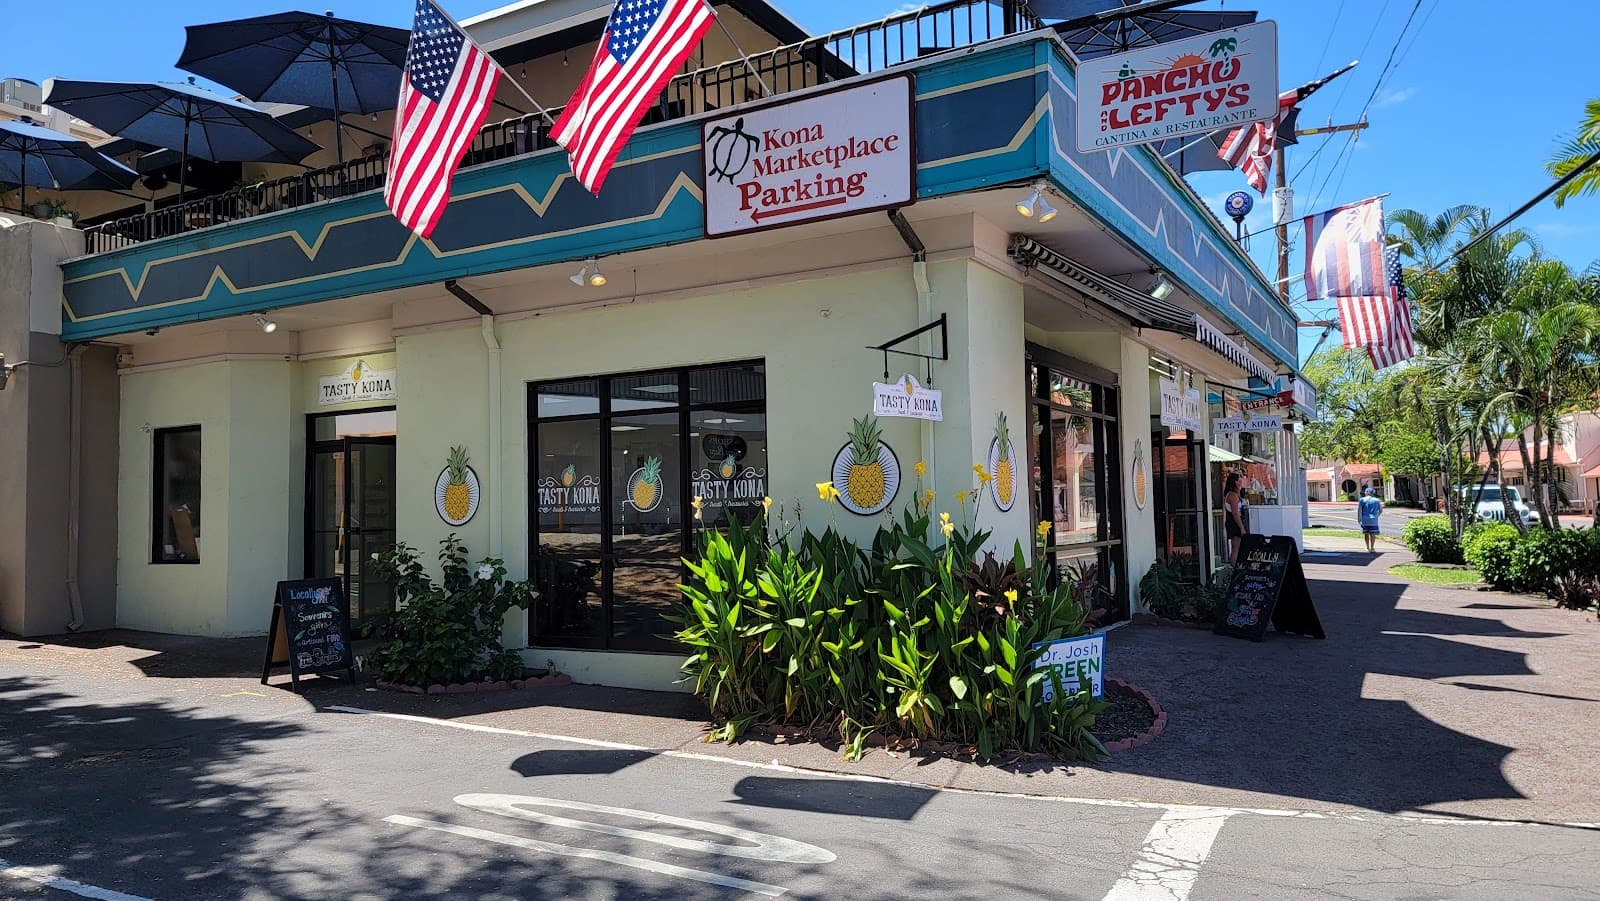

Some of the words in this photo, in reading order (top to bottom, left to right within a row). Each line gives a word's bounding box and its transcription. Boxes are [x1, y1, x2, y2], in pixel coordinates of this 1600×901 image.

[1101, 58, 1241, 106] PANCHO
[1109, 83, 1250, 130] LEFTY'S
[762, 124, 824, 152] Kona
[1095, 128, 1147, 147] CANTINA
[1152, 126, 1160, 136] &
[1166, 108, 1257, 134] RESTAURANTE
[752, 134, 899, 179] Marketplace
[736, 171, 868, 211] Parking
[323, 382, 358, 397] TASTY
[362, 379, 392, 393] KONA
[879, 394, 910, 409] TASTY
[914, 398, 938, 412] KONA
[1163, 393, 1183, 416] TASTY
[1217, 421, 1248, 430] TASTY
[1252, 419, 1277, 428] KONA
[538, 488, 570, 505] TASTY
[573, 487, 600, 504] KONA
[692, 480, 729, 499] TASTY
[733, 479, 765, 499] KONA
[1040, 650, 1062, 662] Dr.
[1066, 642, 1098, 659] Josh
